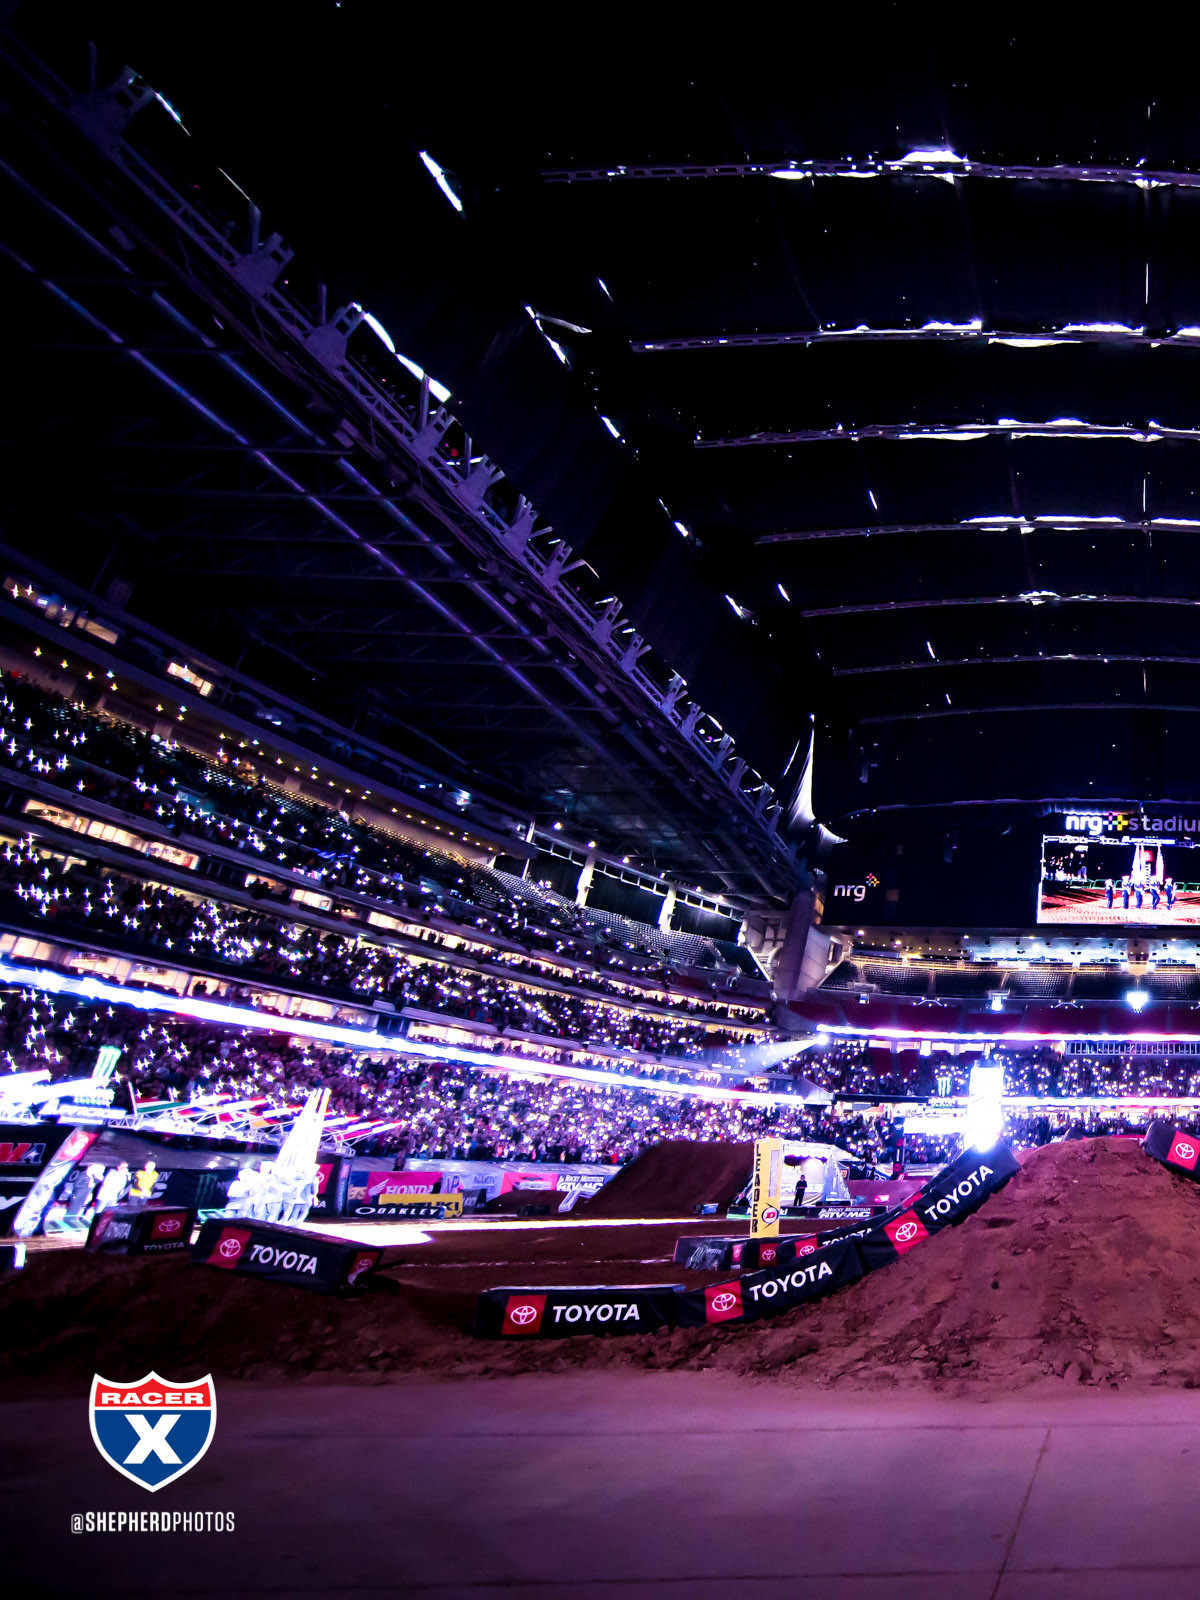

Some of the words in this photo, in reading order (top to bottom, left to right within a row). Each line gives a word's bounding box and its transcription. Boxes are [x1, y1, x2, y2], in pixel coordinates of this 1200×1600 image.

[1065, 815, 1103, 836] nrg
[833, 884, 866, 902] nrg
[752, 1143, 762, 1234] LEADER
[924, 1164, 994, 1221] TOYOTA
[376, 1207, 439, 1216] OAKLEY
[144, 1242, 185, 1250] TOYOTA
[250, 1244, 318, 1275] TOYOTA
[749, 1261, 833, 1302] TOYOTA
[552, 1303, 641, 1323] TOYOTA
